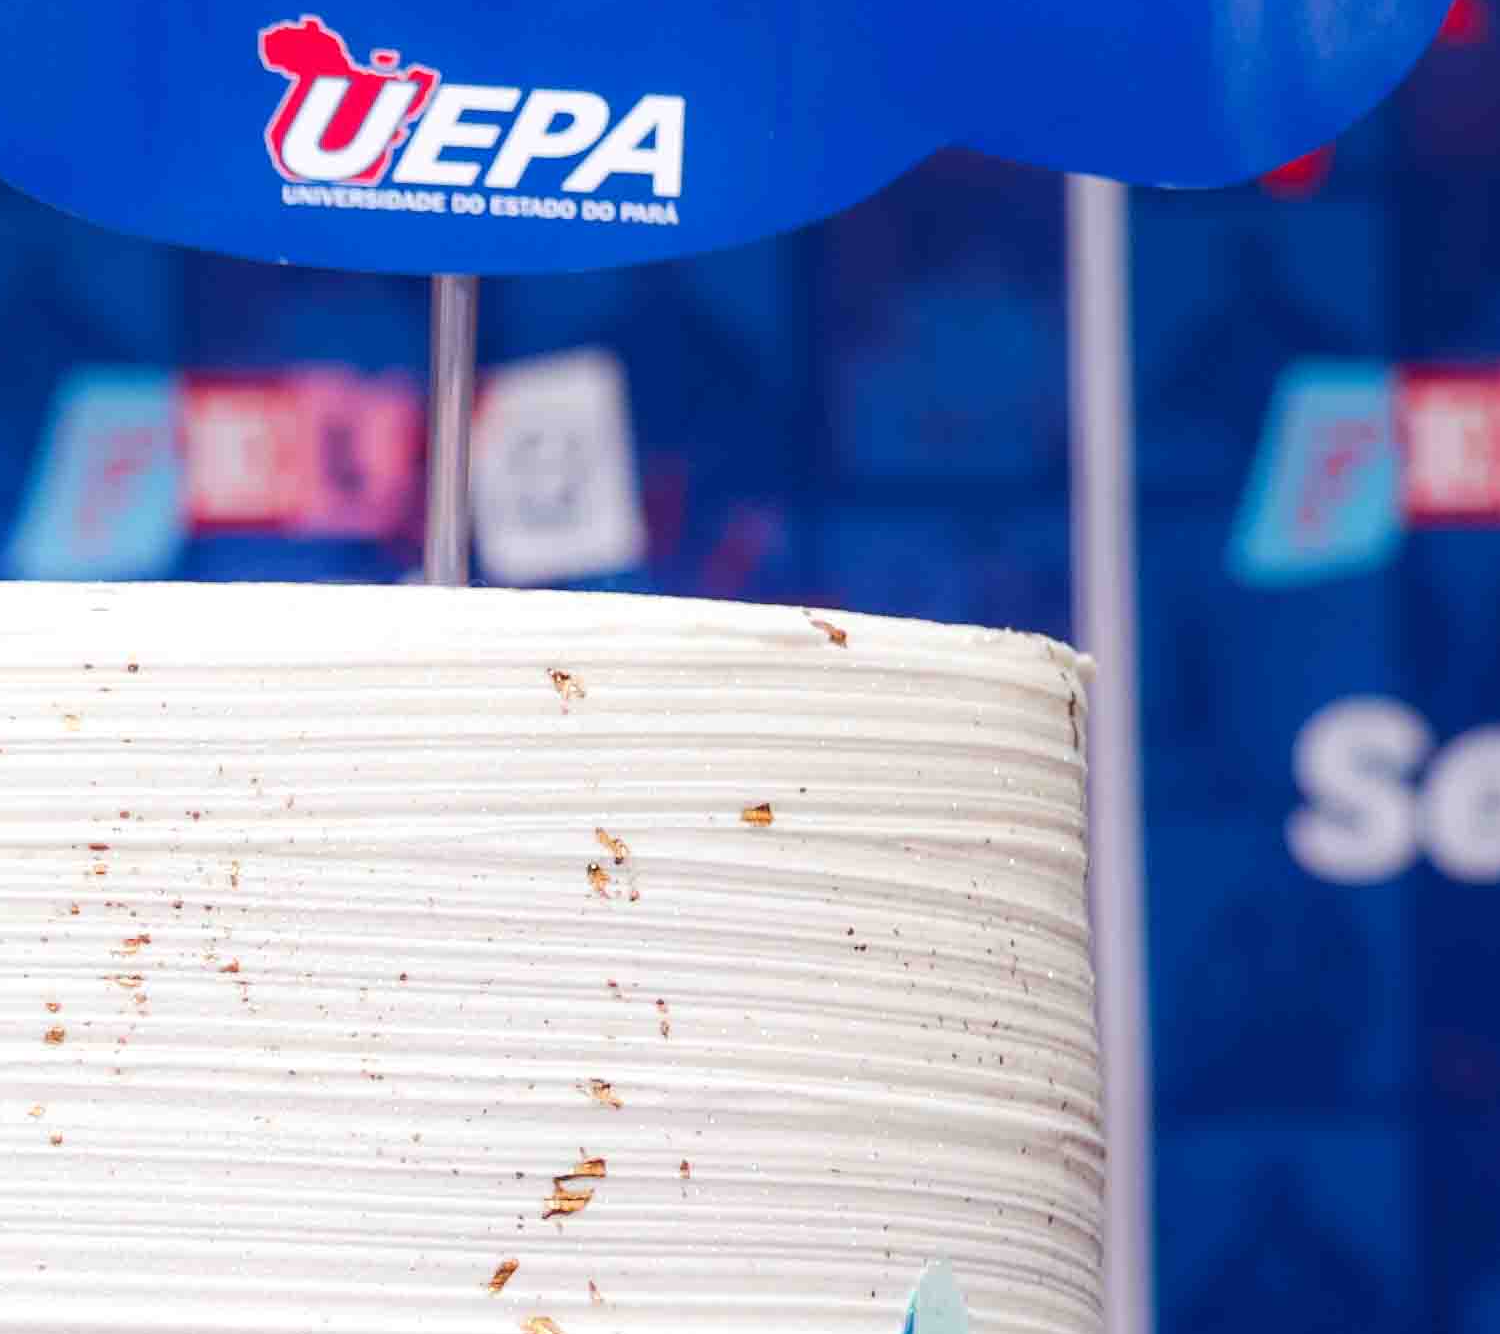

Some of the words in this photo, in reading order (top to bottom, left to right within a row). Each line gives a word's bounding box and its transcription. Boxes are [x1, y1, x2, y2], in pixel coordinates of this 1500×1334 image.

[280, 74, 687, 197] UEPA
[282, 186, 446, 214] UNIVERSIDADE
[451, 193, 486, 216] DO
[490, 195, 576, 220] ESTADO
[582, 200, 614, 222] DO
